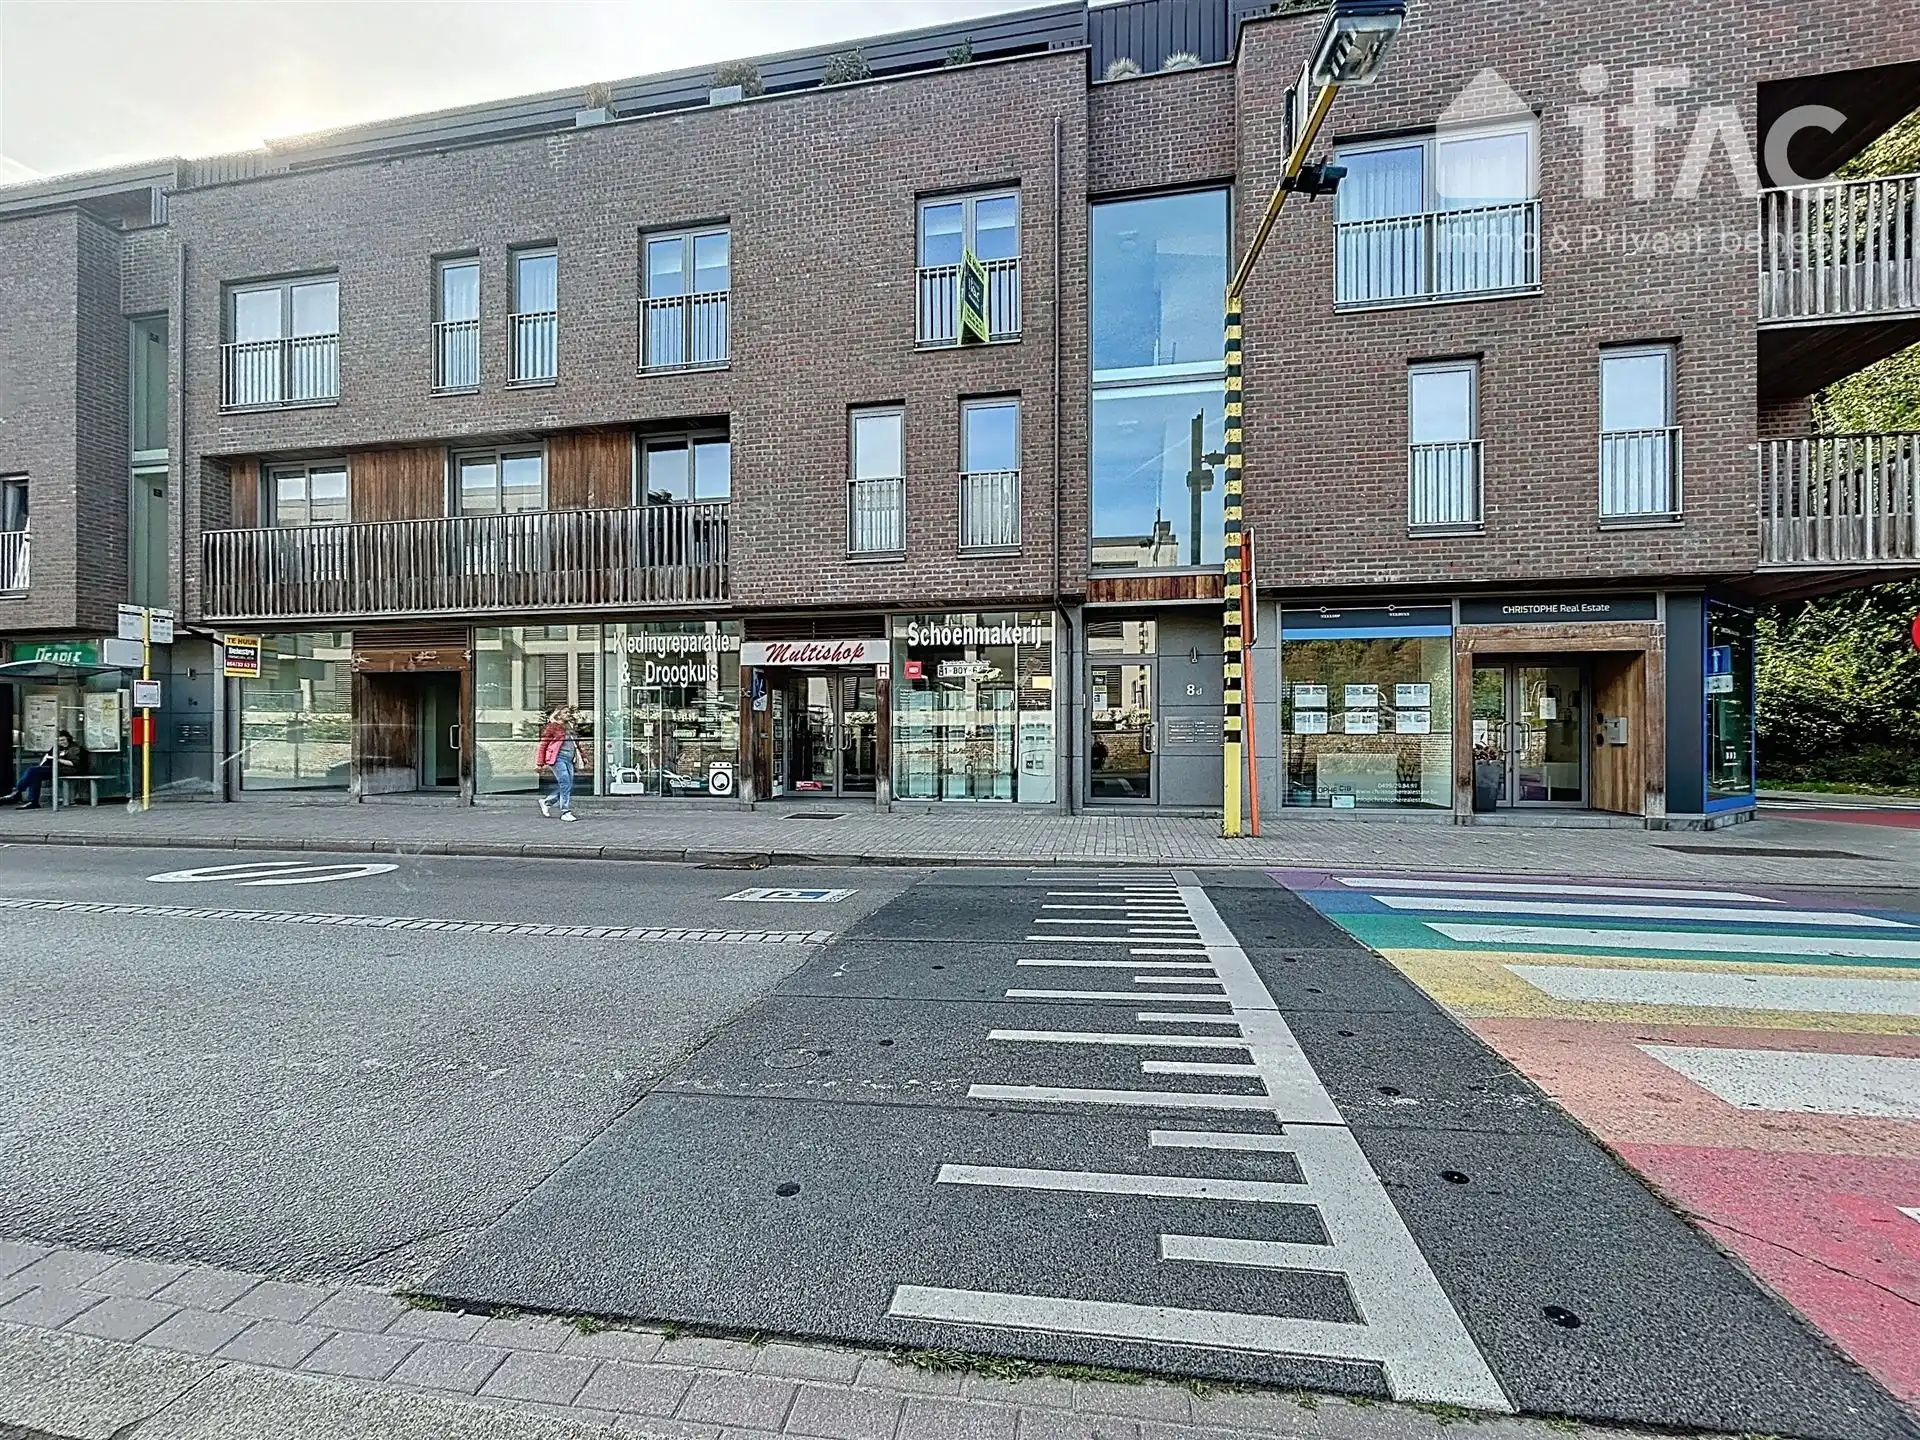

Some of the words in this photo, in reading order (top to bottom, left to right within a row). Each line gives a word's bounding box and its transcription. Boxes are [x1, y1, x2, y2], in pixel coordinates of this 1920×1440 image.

[1502, 604, 1558, 614] CHRISTOPHE
[1560, 604, 1580, 613] Real
[1581, 603, 1611, 613] Estate
[227, 637, 237, 645] TE
[238, 638, 258, 646] HUUR
[907, 619, 1042, 649] Schoenmakerij
[765, 641, 865, 663] Multishop
[620, 661, 631, 684] &
[645, 658, 719, 688] Droogkuis
[1186, 684, 1203, 696] 8d
